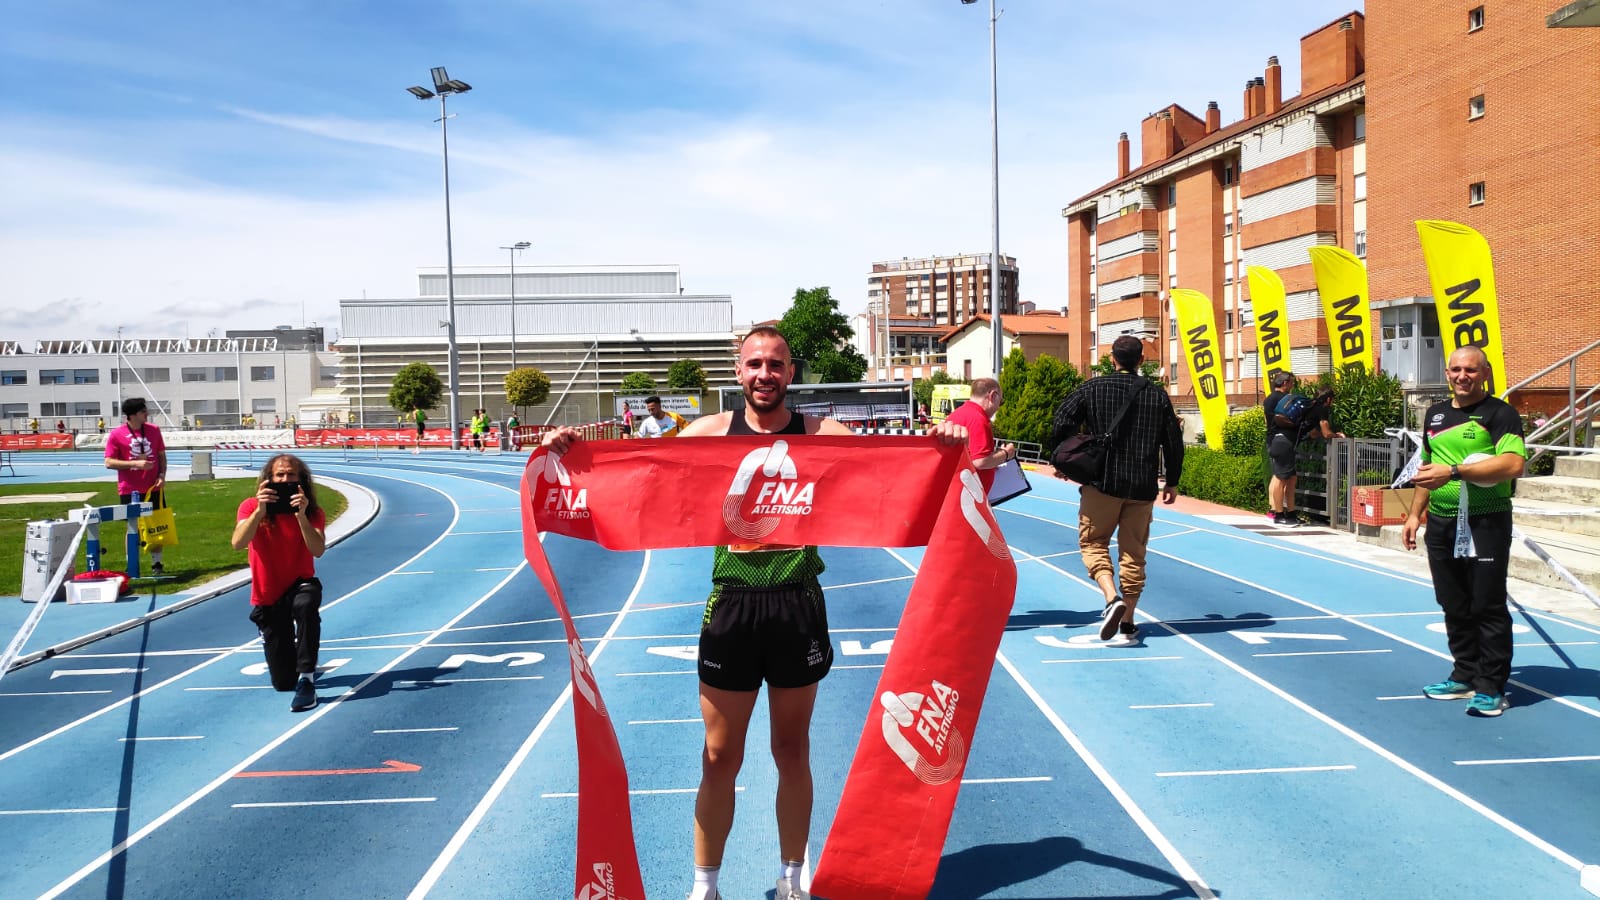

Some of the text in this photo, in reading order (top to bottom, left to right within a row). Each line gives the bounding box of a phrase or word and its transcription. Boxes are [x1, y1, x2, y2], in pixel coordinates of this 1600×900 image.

[1258, 309, 1282, 366] BM
[1332, 294, 1364, 359] BM
[1444, 278, 1490, 350] BM
[1186, 323, 1215, 374] BM
[543, 487, 588, 511] FNA
[751, 504, 813, 516] ATLETISMO
[755, 481, 815, 505] FNA
[437, 652, 546, 668] 3
[916, 679, 953, 748] FNA
[934, 690, 959, 756] ATLETISMO
[590, 862, 607, 900] NA
